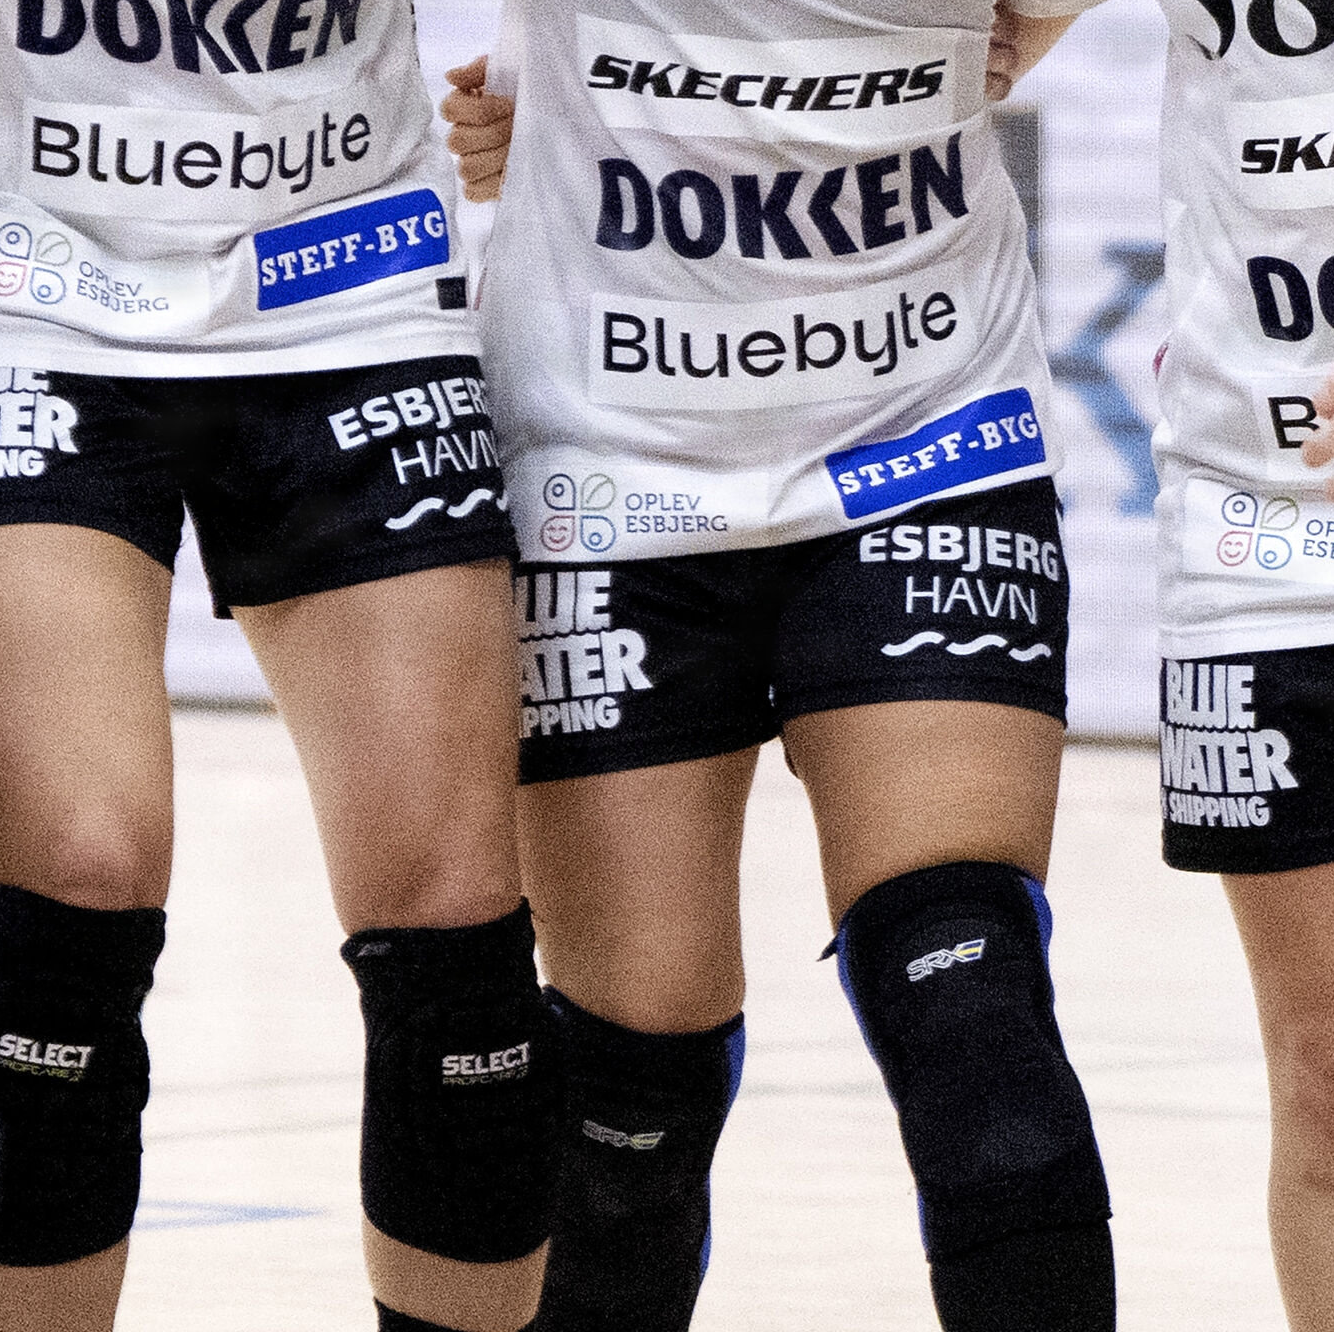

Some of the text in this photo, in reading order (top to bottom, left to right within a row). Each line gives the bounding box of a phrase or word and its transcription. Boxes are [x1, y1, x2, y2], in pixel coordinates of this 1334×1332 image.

[588, 54, 946, 111] SKECHERS
[31, 112, 371, 192] Bluebyte
[260, 209, 446, 289] STEFF-BYG
[77, 278, 169, 314] ESBJERG
[79, 261, 142, 297] OPLEV
[603, 291, 957, 378] Bluebyte
[328, 377, 487, 450] ESBJER
[391, 430, 499, 485] HAVN
[838, 412, 1039, 495] STEFF-BYG
[625, 493, 701, 512] OPLEV
[626, 514, 728, 534] ESBJERG
[860, 525, 1059, 581] ESBJERG
[515, 571, 611, 640] LUE
[906, 576, 1037, 625] HAVN
[519, 628, 654, 703] ATER
[521, 696, 620, 738] PPING
[1167, 660, 1255, 729] BLUE
[1159, 721, 1299, 793] WATER
[1169, 790, 1271, 827] SHIPPING
[442, 1041, 530, 1076] SELECT
